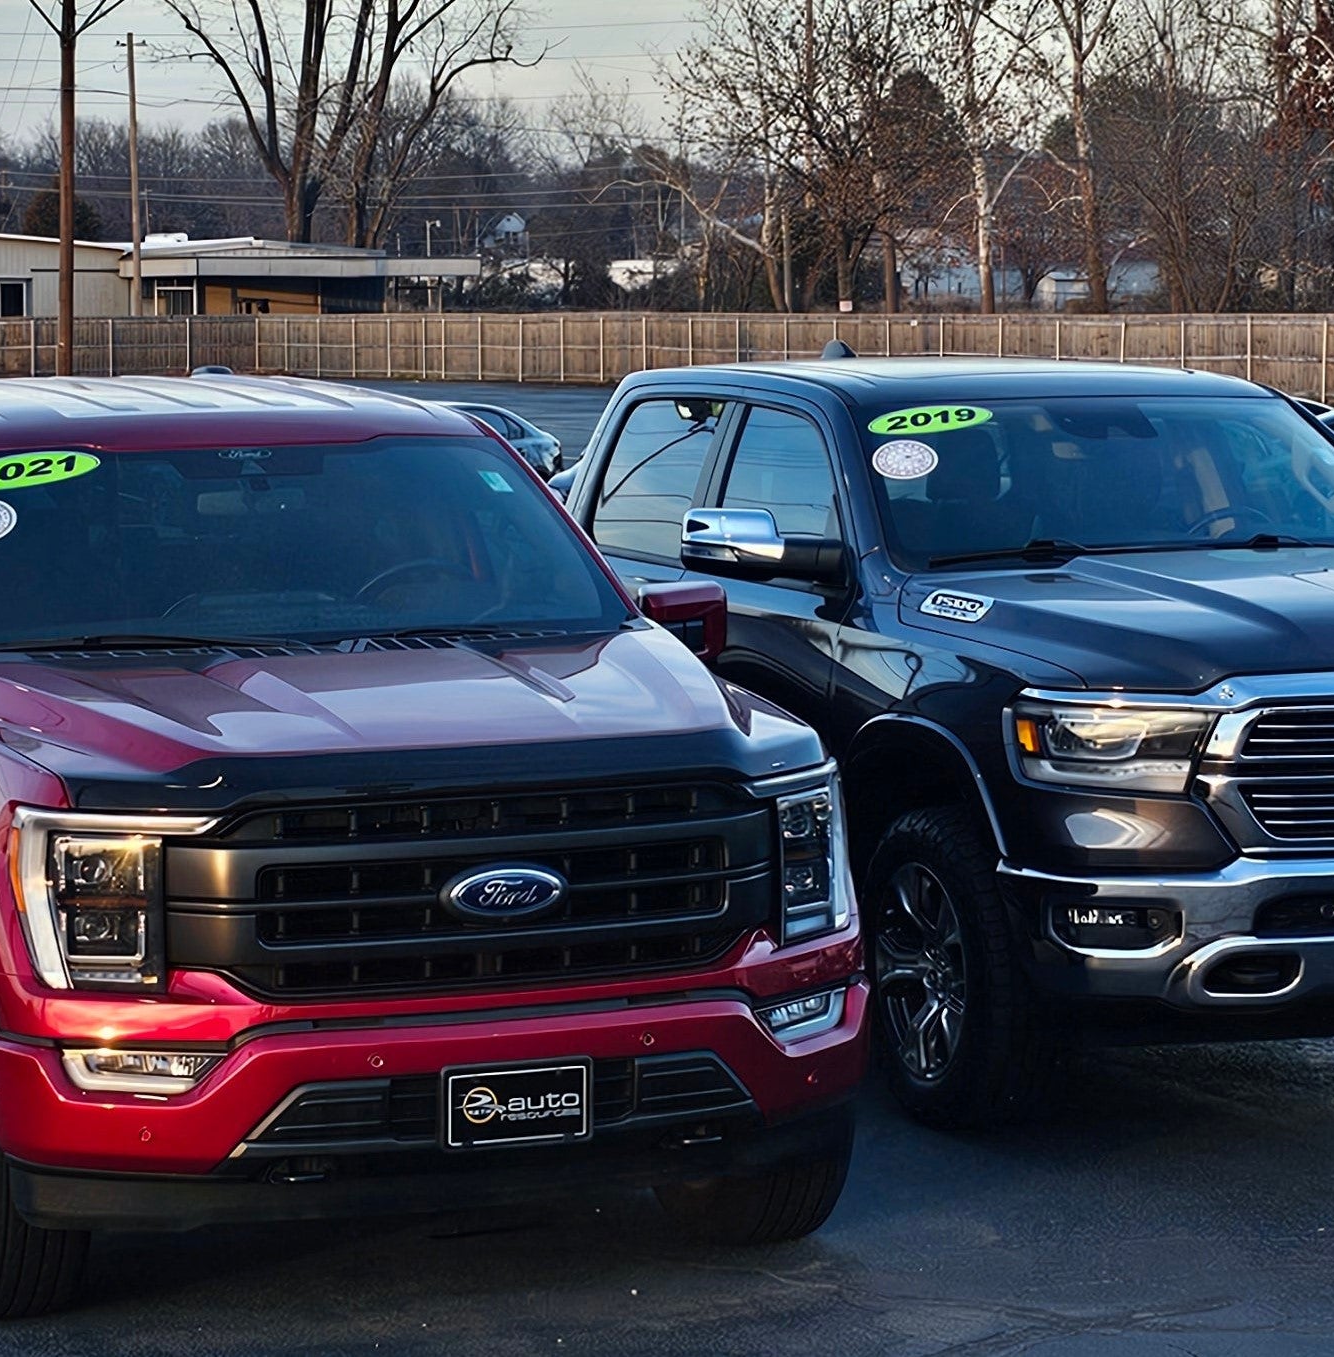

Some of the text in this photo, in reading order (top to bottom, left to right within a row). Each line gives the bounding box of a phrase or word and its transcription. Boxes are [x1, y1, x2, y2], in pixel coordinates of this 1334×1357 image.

[886, 408, 976, 431] 2019
[479, 880, 538, 906] Ford
[508, 1093, 580, 1112] auto
